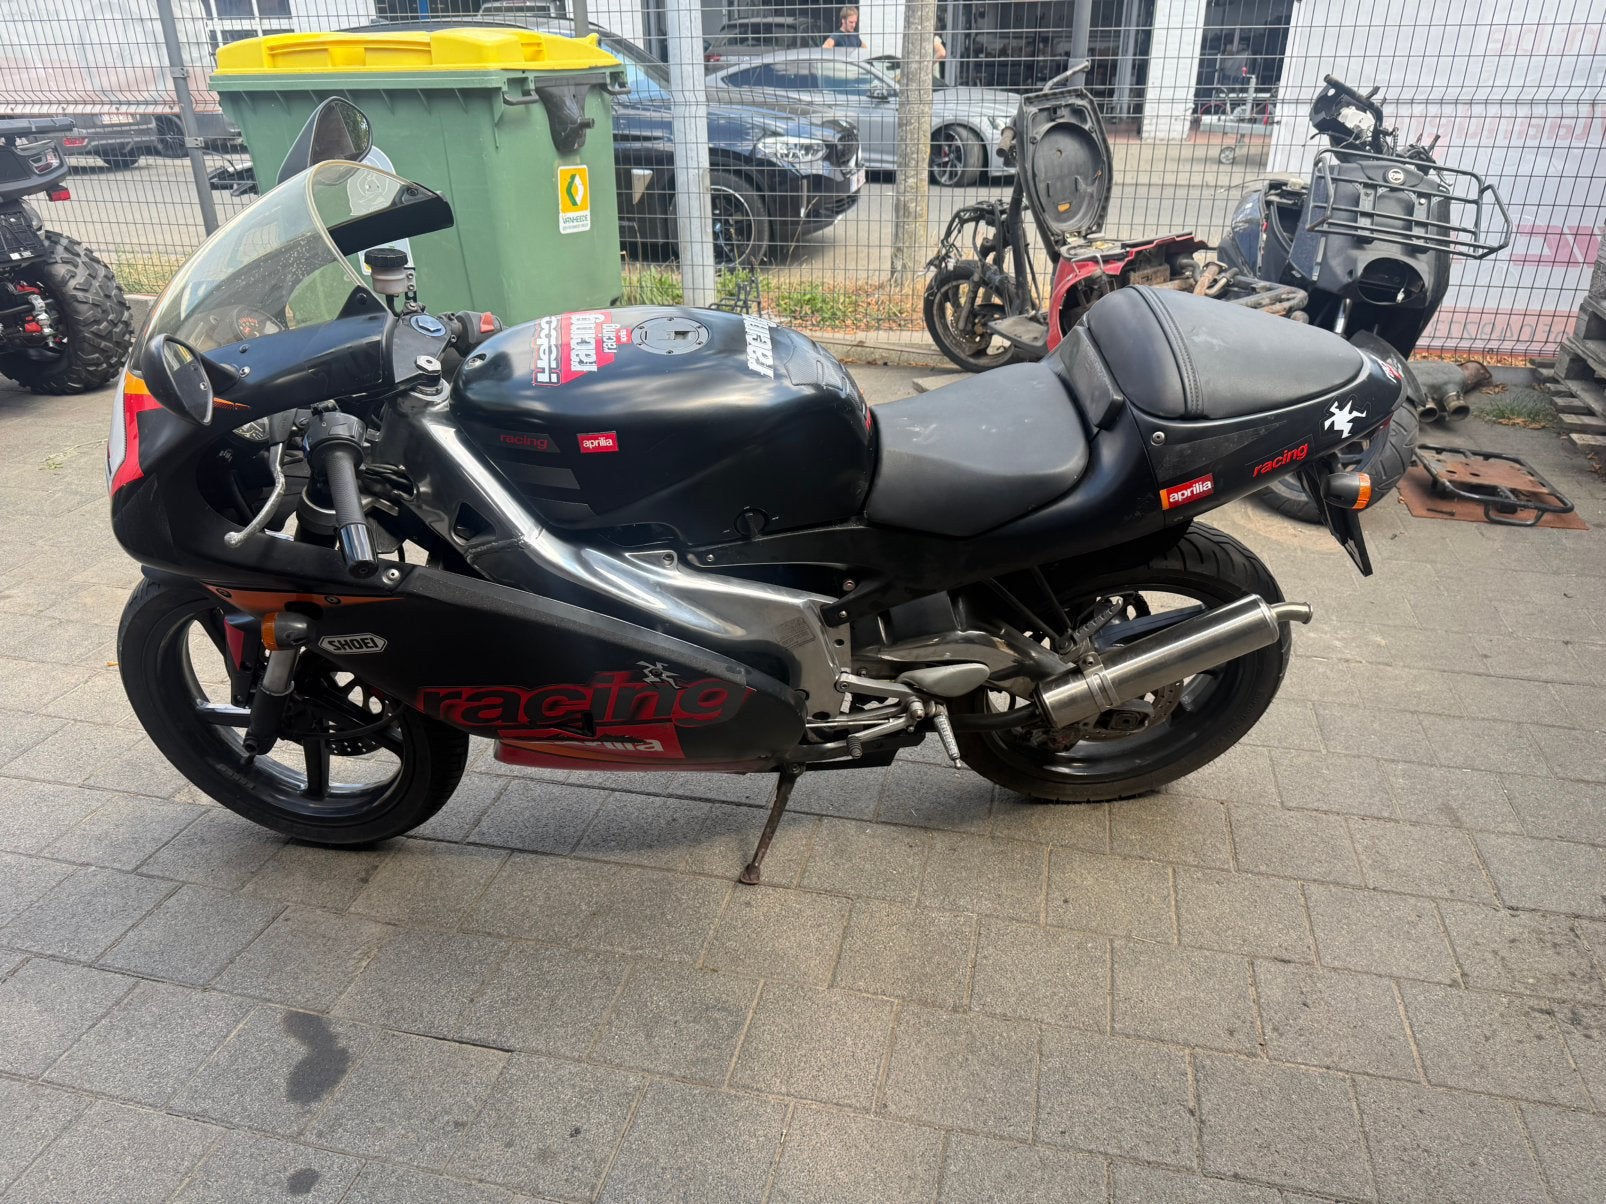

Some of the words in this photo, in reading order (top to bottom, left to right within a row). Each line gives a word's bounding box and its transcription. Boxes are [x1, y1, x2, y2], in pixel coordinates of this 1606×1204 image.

[570, 314, 605, 372] racing
[598, 323, 620, 353] racing
[500, 434, 549, 450] racing
[583, 437, 613, 449] aprilia
[1253, 443, 1309, 478] racing
[1169, 481, 1212, 504] aprilia
[327, 636, 379, 651] SHOEI
[420, 672, 748, 728] racing
